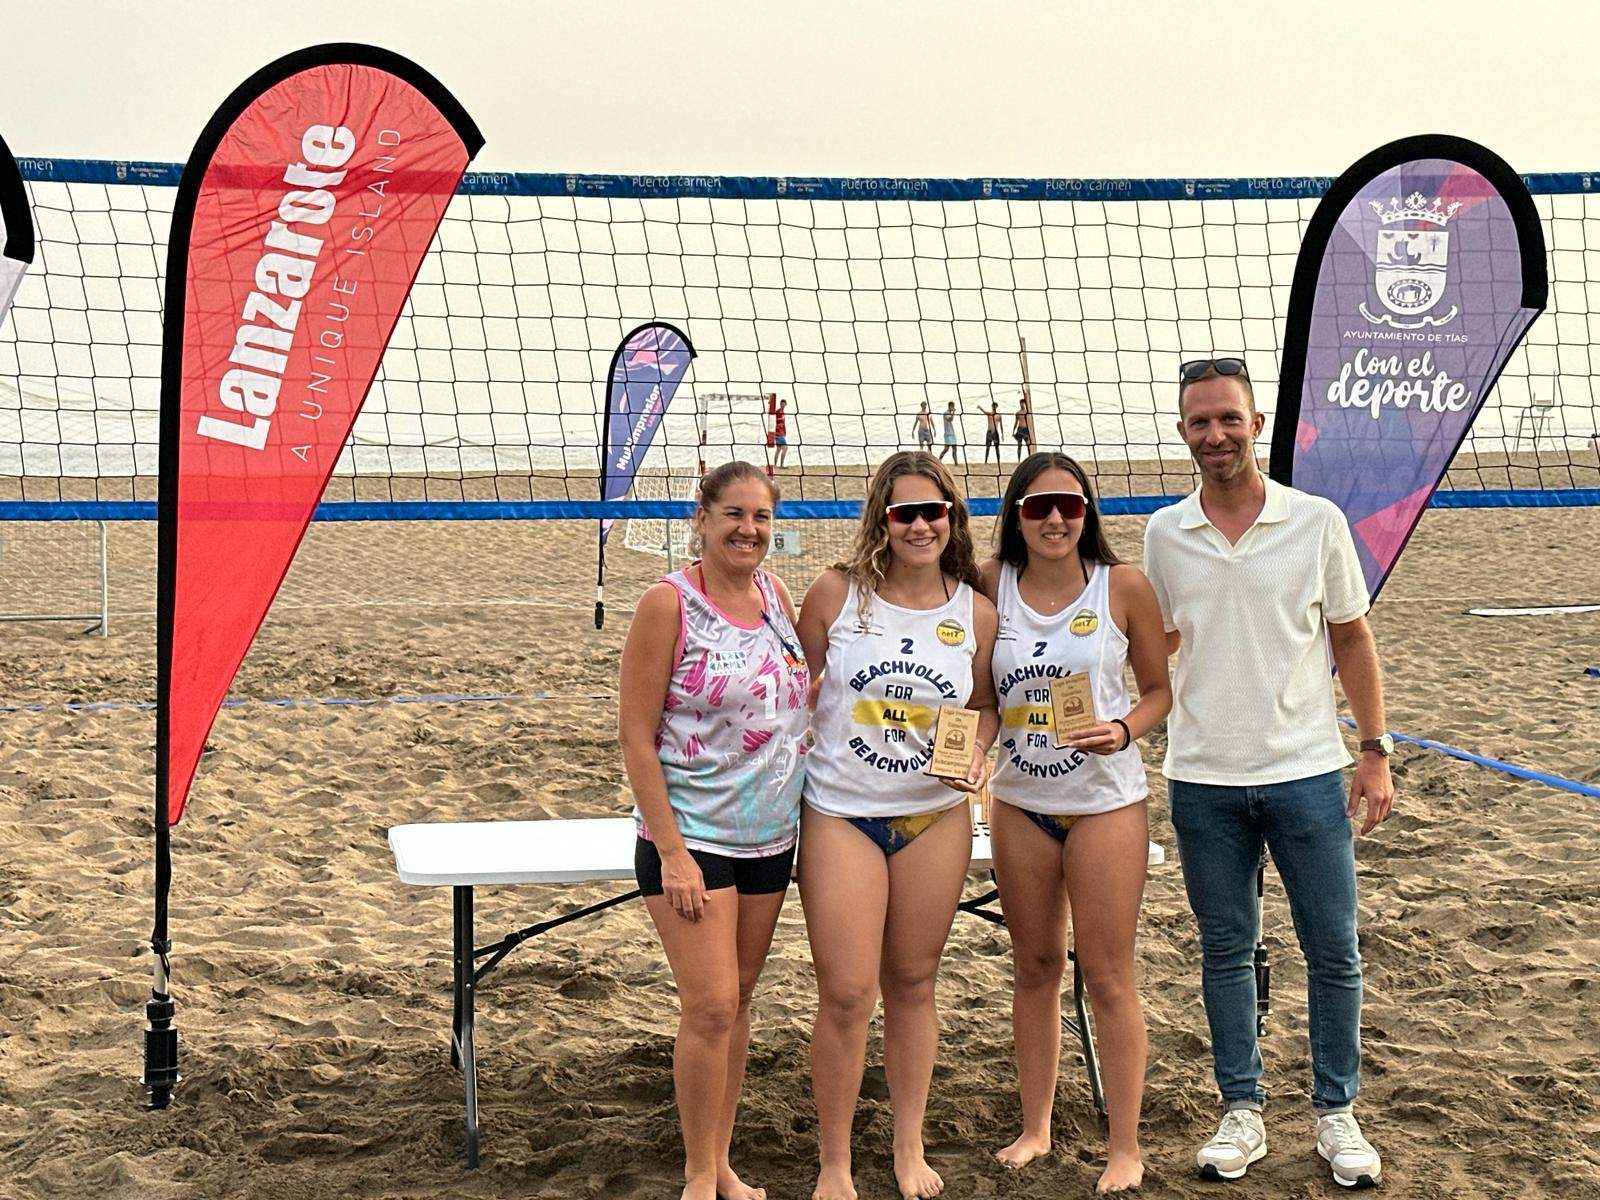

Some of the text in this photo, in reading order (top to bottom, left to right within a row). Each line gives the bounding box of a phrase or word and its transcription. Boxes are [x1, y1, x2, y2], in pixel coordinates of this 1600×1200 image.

[17, 158, 53, 171] rmen
[197, 124, 355, 450] Lanzarote
[291, 128, 401, 462] A UNIQUE ISLAND
[1344, 331, 1468, 343] AYUNTAMIENTO DE TÍAS
[1354, 348, 1435, 377] Con el
[1327, 362, 1472, 419] deporte
[900, 638, 914, 654] 2
[1032, 641, 1047, 658] 2
[849, 660, 957, 699] BEACHVOLLEY
[756, 673, 777, 719] 1
[885, 684, 914, 700] FOR
[1024, 688, 1049, 703] FOR
[882, 708, 907, 722] ALL
[1028, 712, 1049, 725] ALL
[884, 728, 907, 743] FOR
[1026, 733, 1048, 748] FOR
